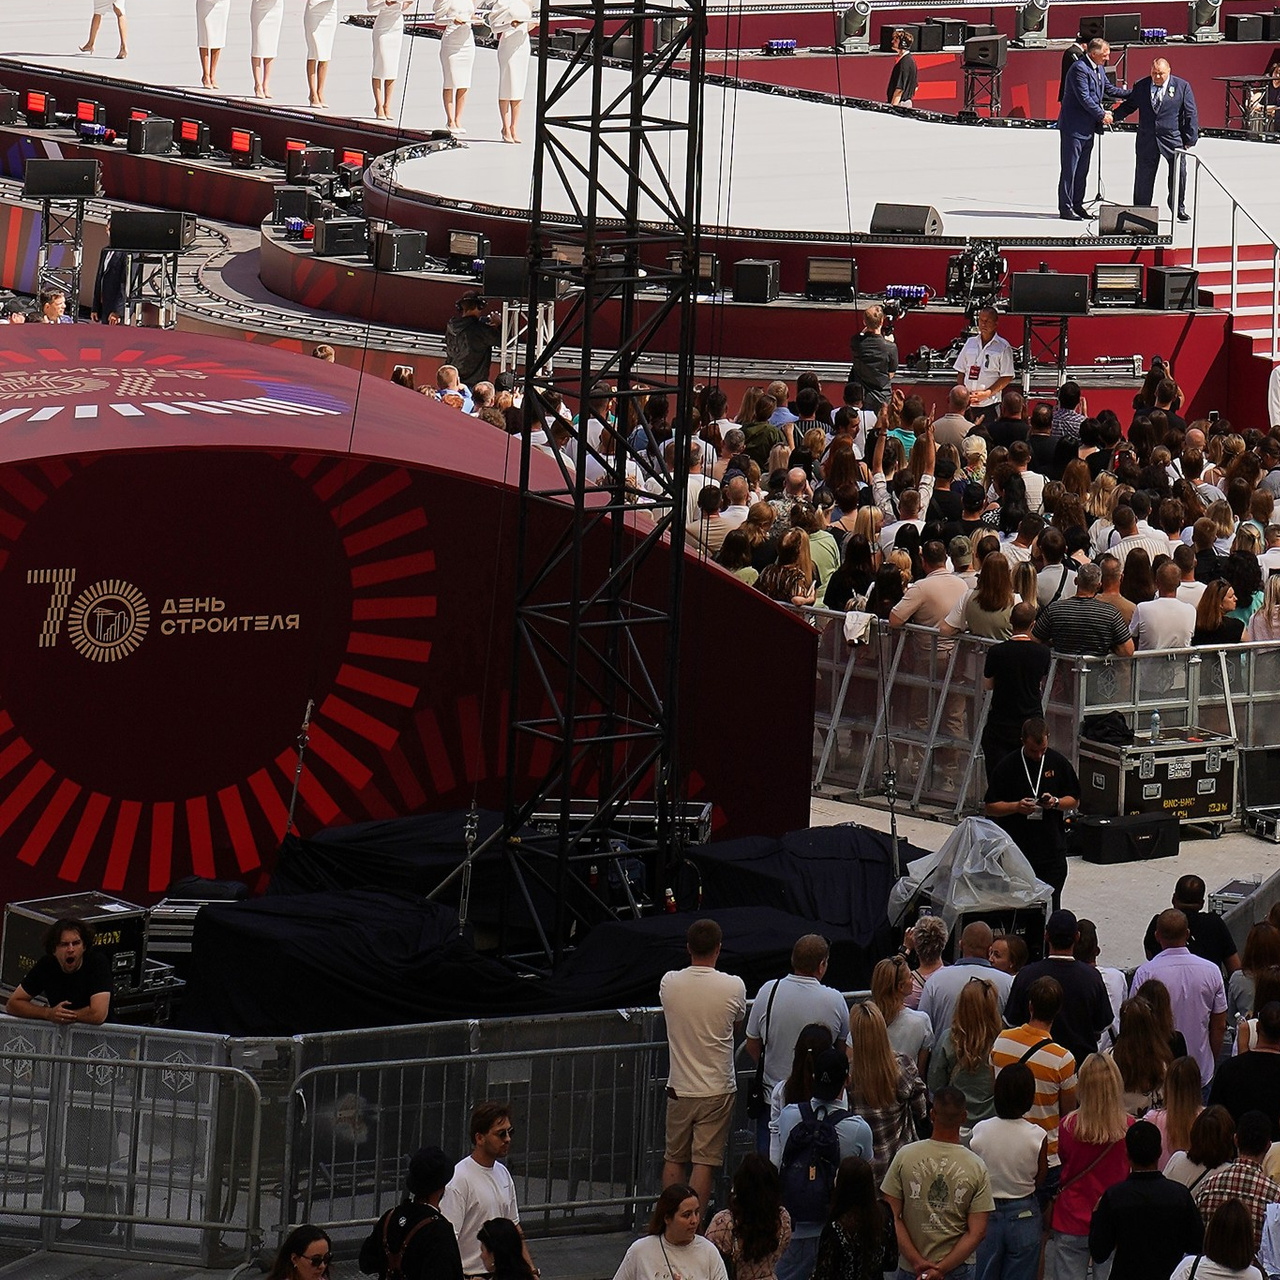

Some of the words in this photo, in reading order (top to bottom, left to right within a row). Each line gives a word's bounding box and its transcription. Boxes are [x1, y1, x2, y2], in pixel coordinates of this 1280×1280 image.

[27, 568, 151, 663] 70
[160, 596, 227, 615] ДЕНЬ
[159, 613, 301, 636] СТРОИТЕЛЯ
